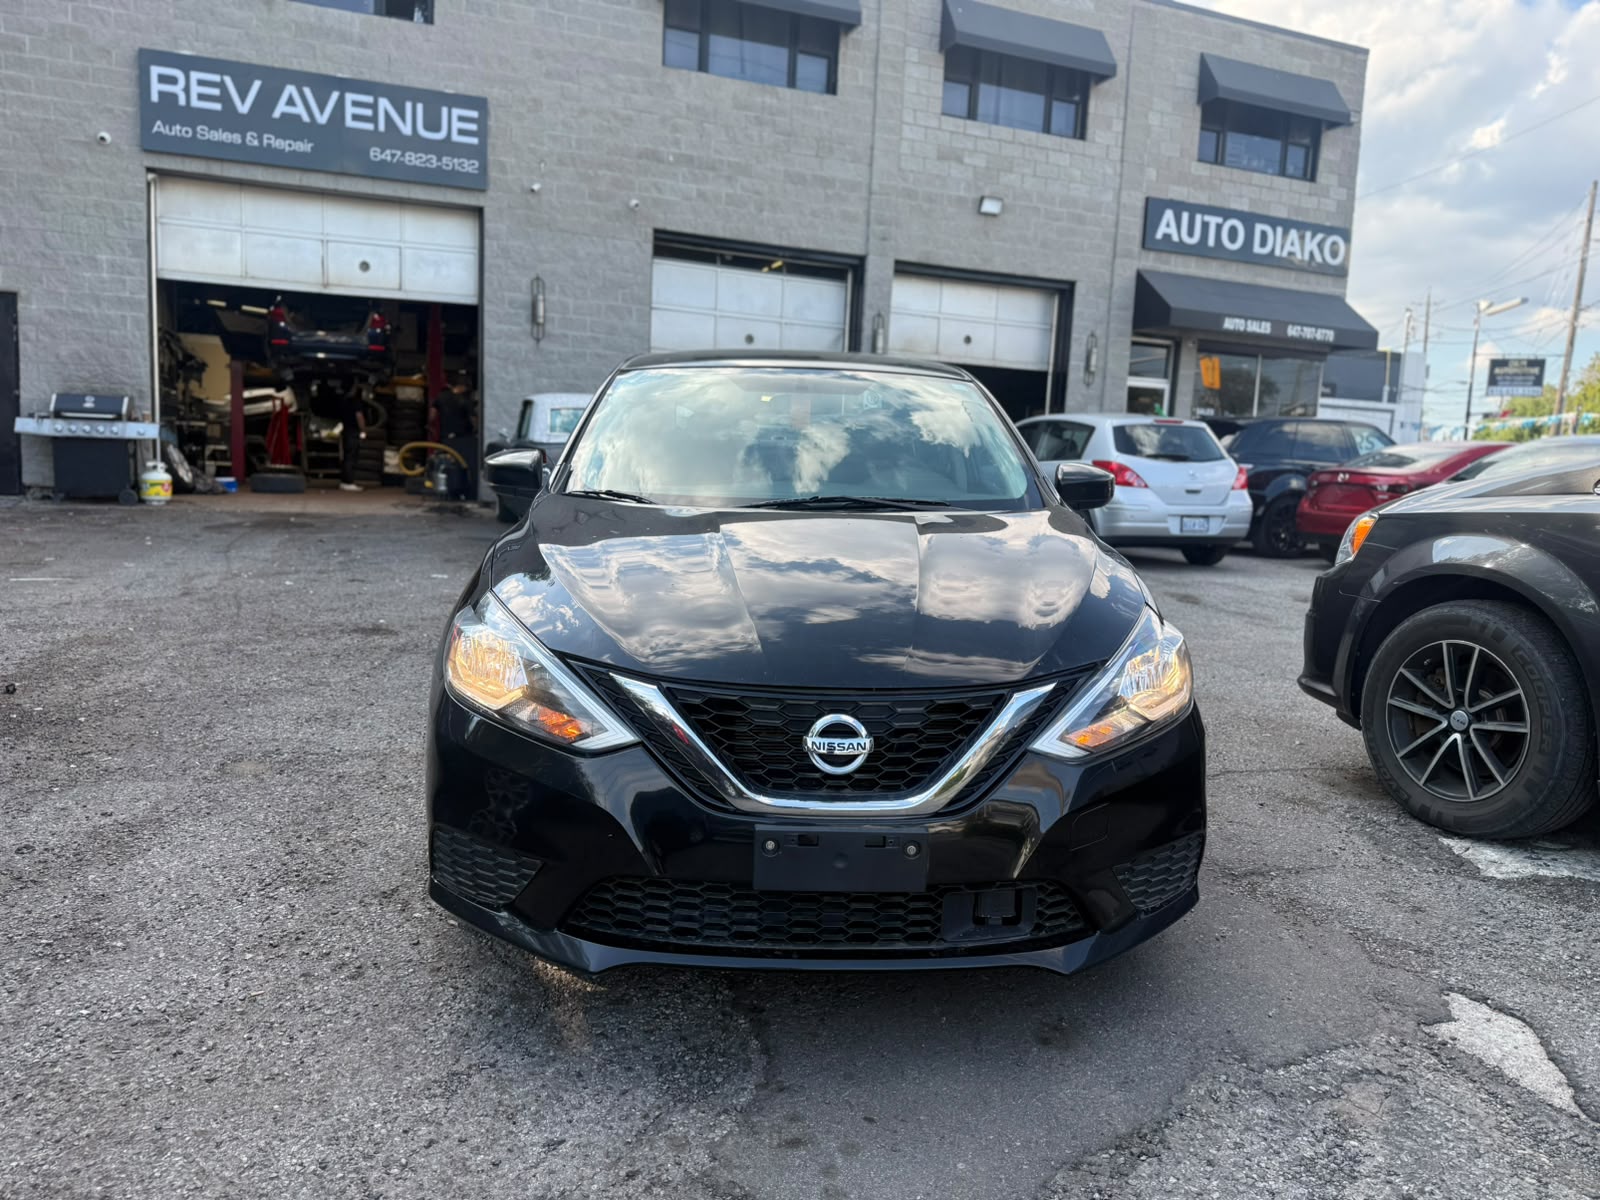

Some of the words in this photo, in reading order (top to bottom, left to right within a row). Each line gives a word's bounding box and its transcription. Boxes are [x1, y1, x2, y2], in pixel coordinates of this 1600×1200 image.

[149, 65, 262, 115] REV
[271, 84, 479, 145] AVENUE
[151, 120, 193, 138] Auto
[196, 125, 242, 145] Sales
[245, 131, 260, 147] &
[263, 134, 314, 153] Repair
[369, 147, 479, 174] 647-823-5132
[1155, 208, 1245, 251] AUTO
[1252, 222, 1346, 266] DIAKO
[1222, 316, 1246, 332] AUTO
[1246, 319, 1271, 335] SALES
[811, 741, 867, 752] NISSAN
